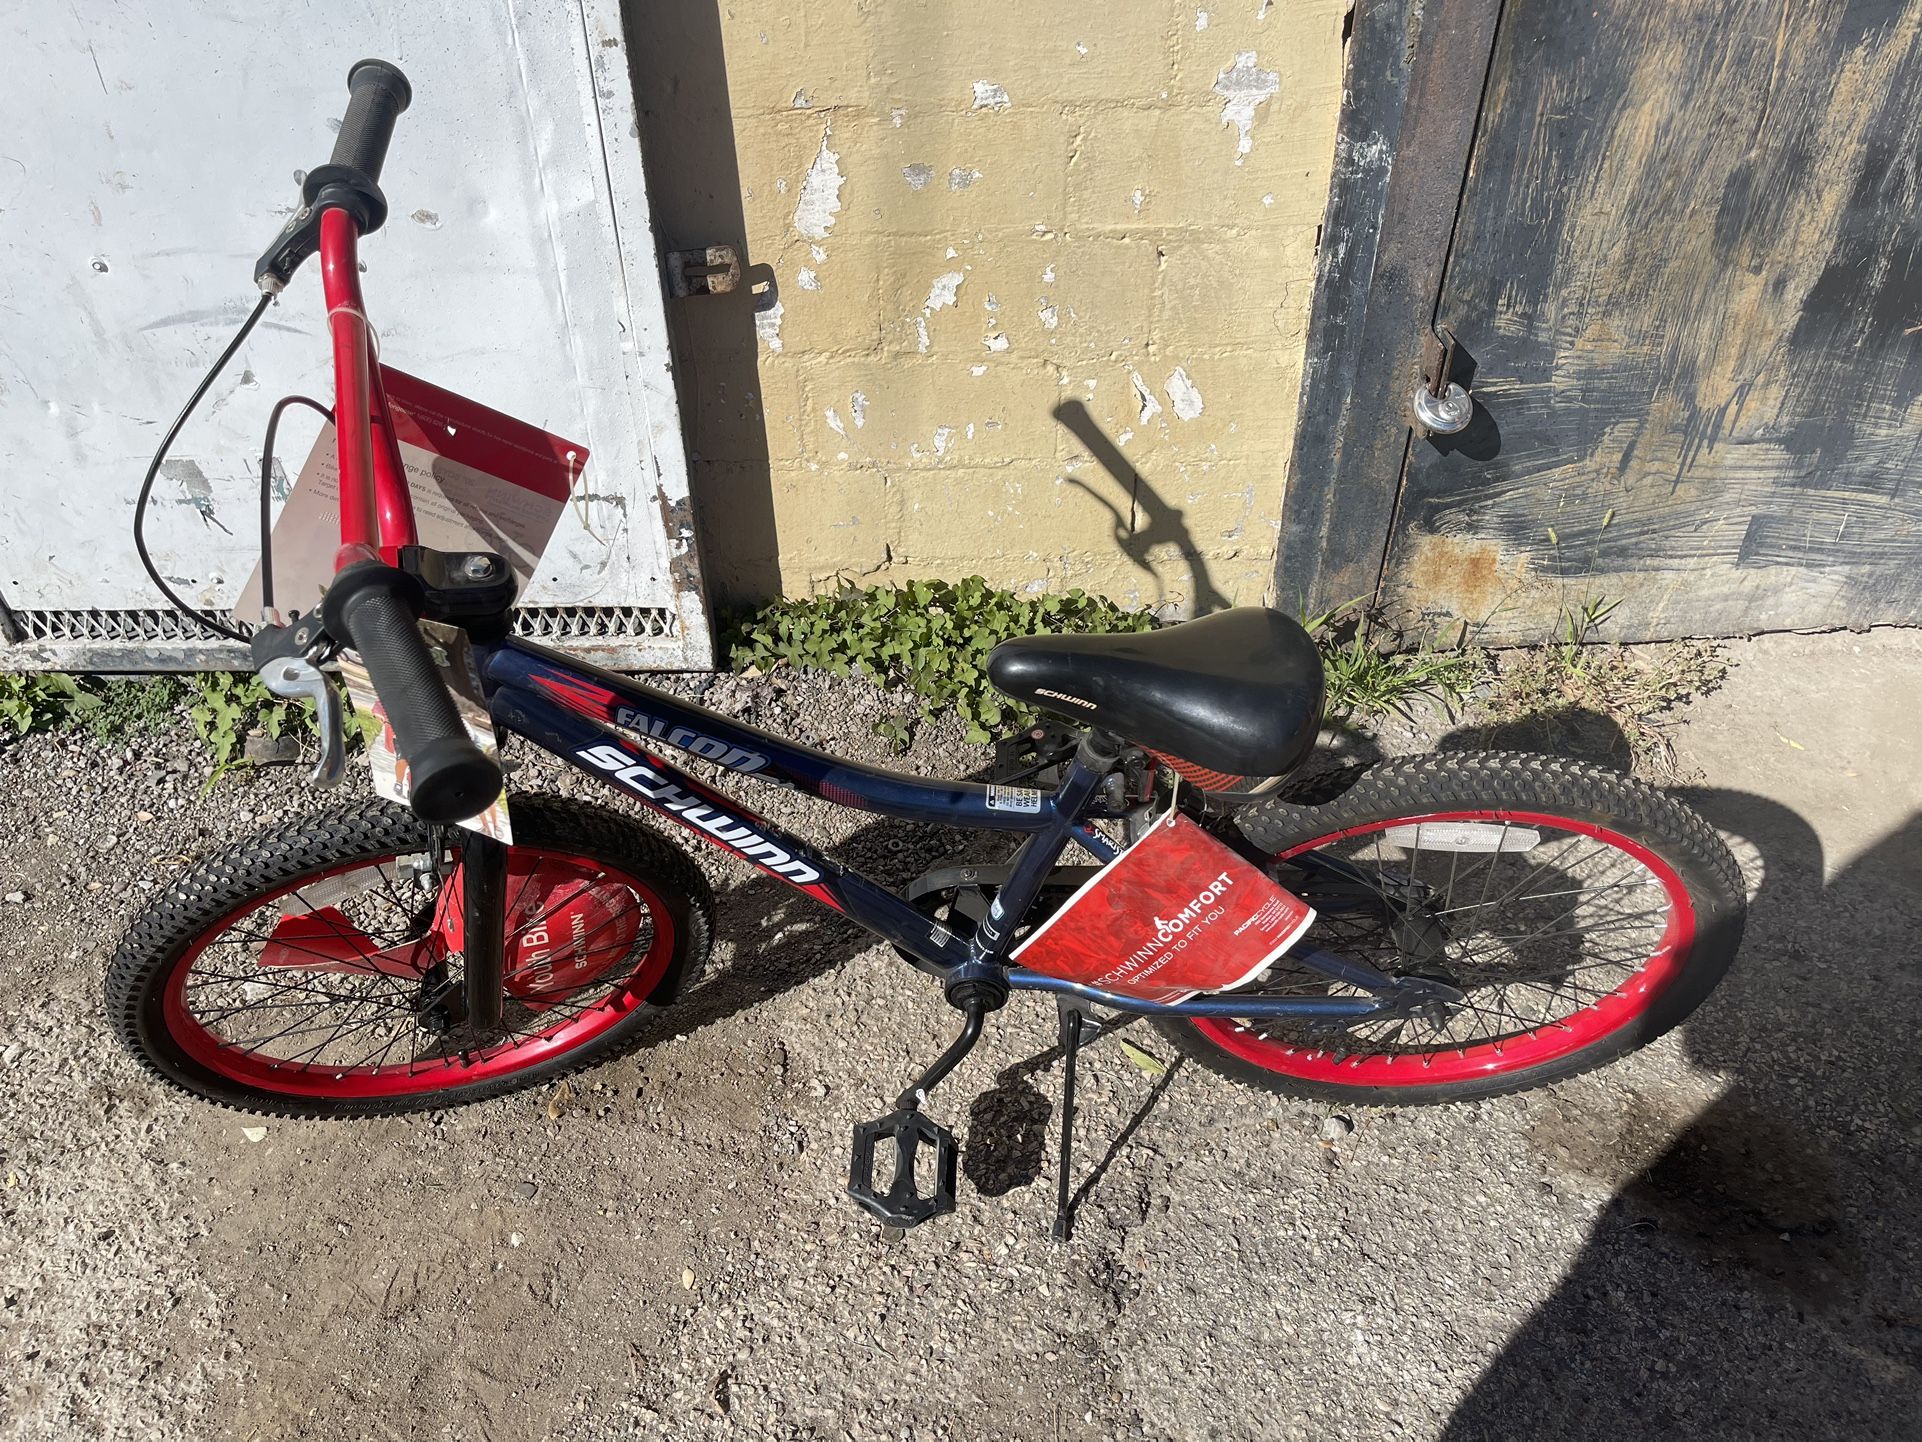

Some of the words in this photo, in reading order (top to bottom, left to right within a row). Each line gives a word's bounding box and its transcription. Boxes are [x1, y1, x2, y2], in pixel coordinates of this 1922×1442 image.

[410, 481, 426, 492] DAYS
[420, 469, 445, 482] policy
[1034, 688, 1098, 710] SCHWINN
[617, 707, 770, 773] FALCON
[576, 745, 820, 884] SCHWINN
[570, 912, 588, 969] SCHWINN
[1127, 951, 1174, 985] OPTIMIZED
[1171, 939, 1188, 952] TO
[1186, 924, 1202, 941] FIT
[1201, 905, 1225, 926] YOU
[526, 948, 554, 994] Youth
